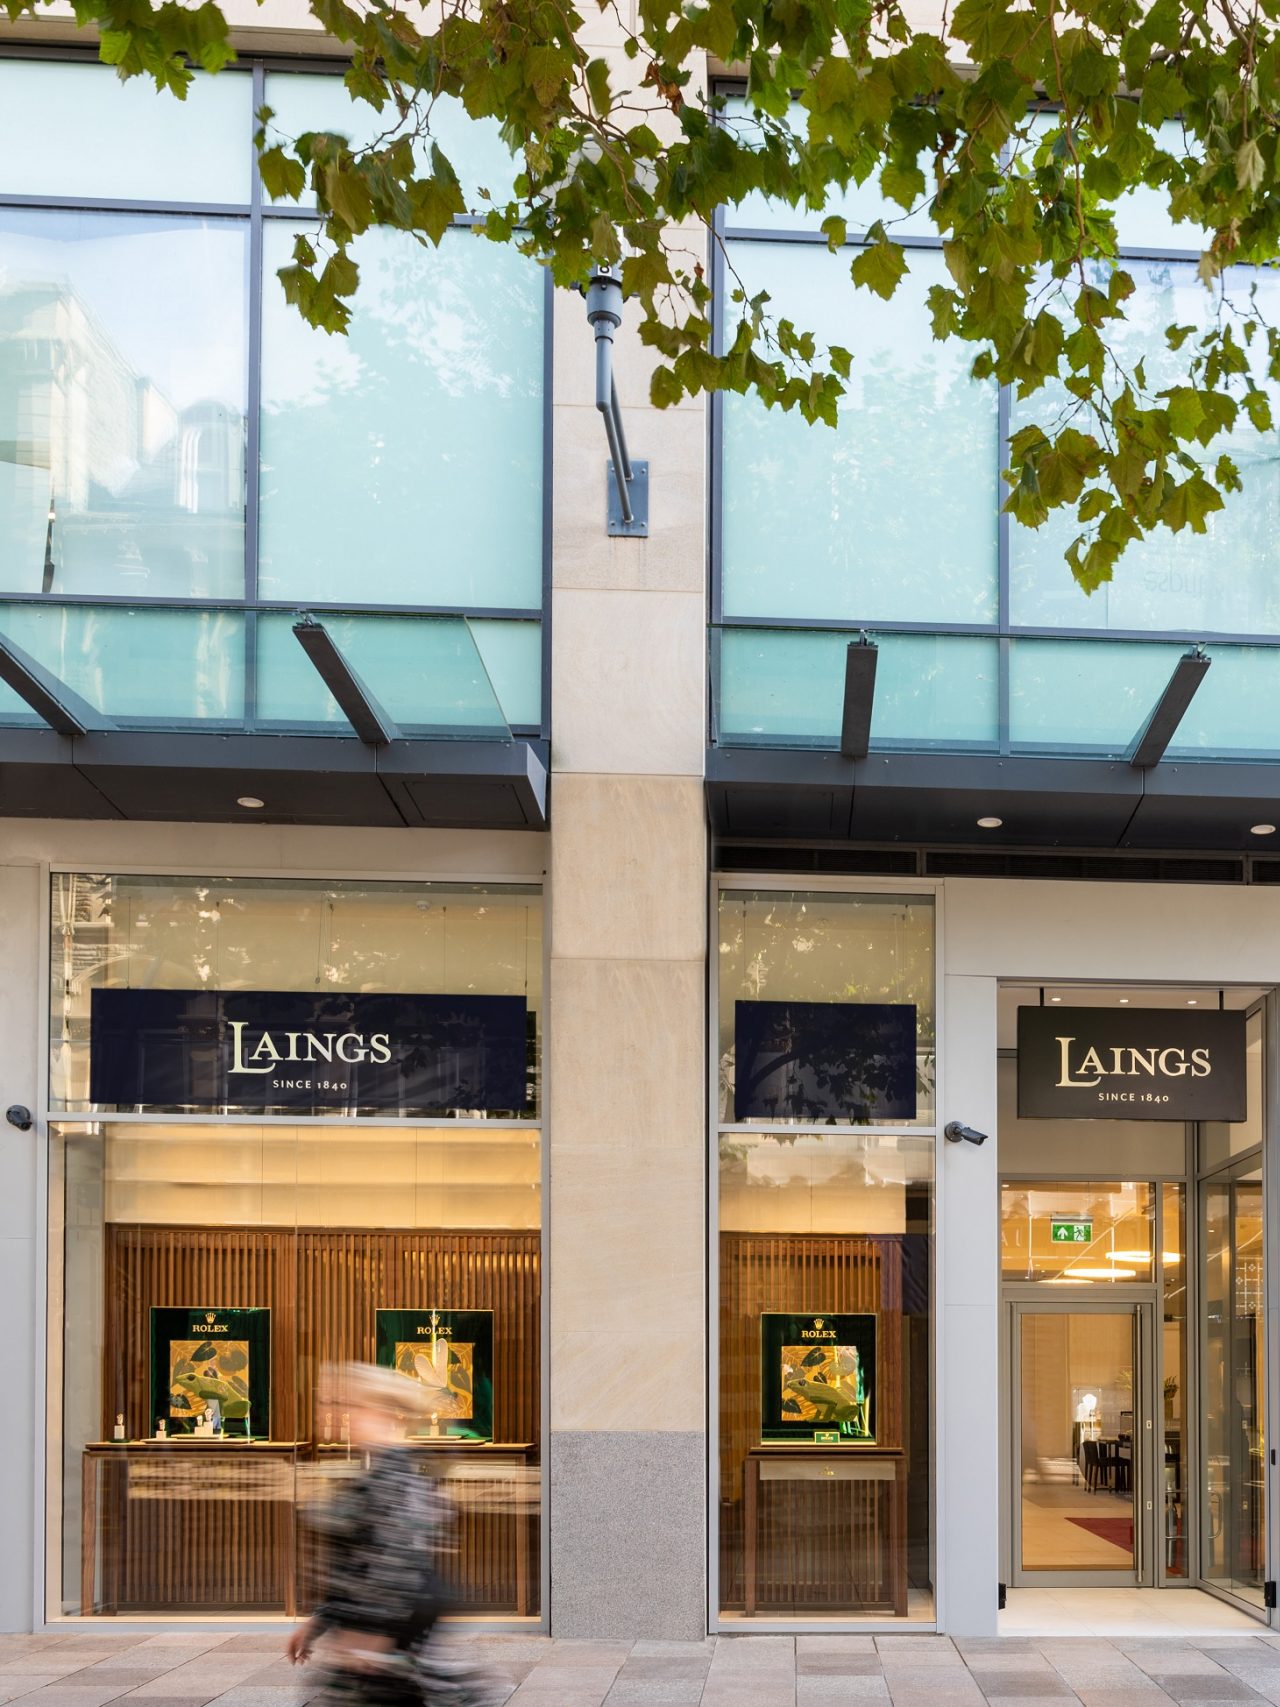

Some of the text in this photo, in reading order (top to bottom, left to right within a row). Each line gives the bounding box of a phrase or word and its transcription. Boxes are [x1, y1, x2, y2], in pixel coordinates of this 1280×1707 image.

[227, 1021, 392, 1074] LAINGS
[1055, 1037, 1212, 1088] LAINGS
[273, 1080, 348, 1091] SINCE 1840
[1098, 1093, 1169, 1104] SINCE 1840
[192, 1325, 228, 1333] ROLEX
[416, 1327, 453, 1335] ROLEX
[801, 1330, 837, 1338] ROLEX
